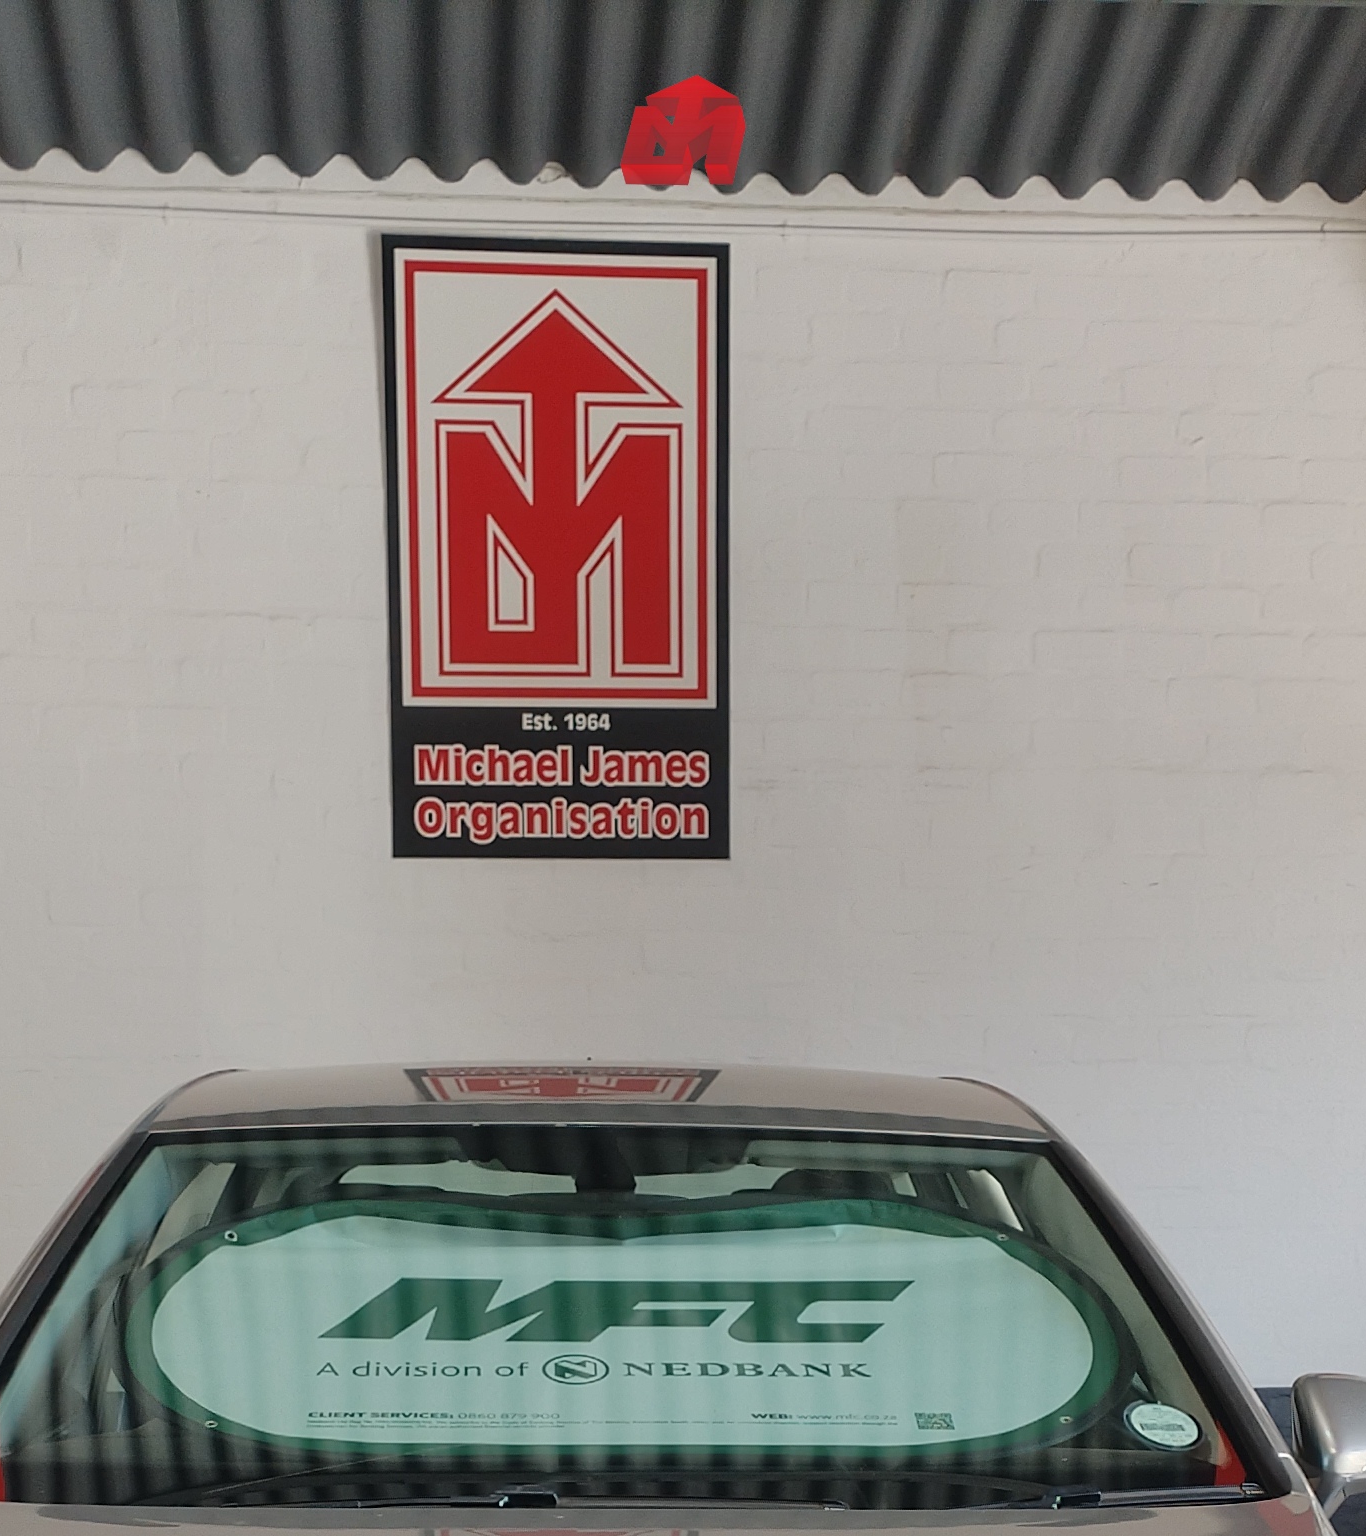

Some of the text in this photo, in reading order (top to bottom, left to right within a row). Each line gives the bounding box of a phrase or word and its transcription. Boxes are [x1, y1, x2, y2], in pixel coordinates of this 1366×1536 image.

[522, 713, 610, 731] Est. 1964
[414, 744, 709, 787] Michael James
[414, 797, 709, 845] Organisation
[318, 1277, 915, 1343] MFC
[317, 1361, 871, 1377] A division of NEDBANK
